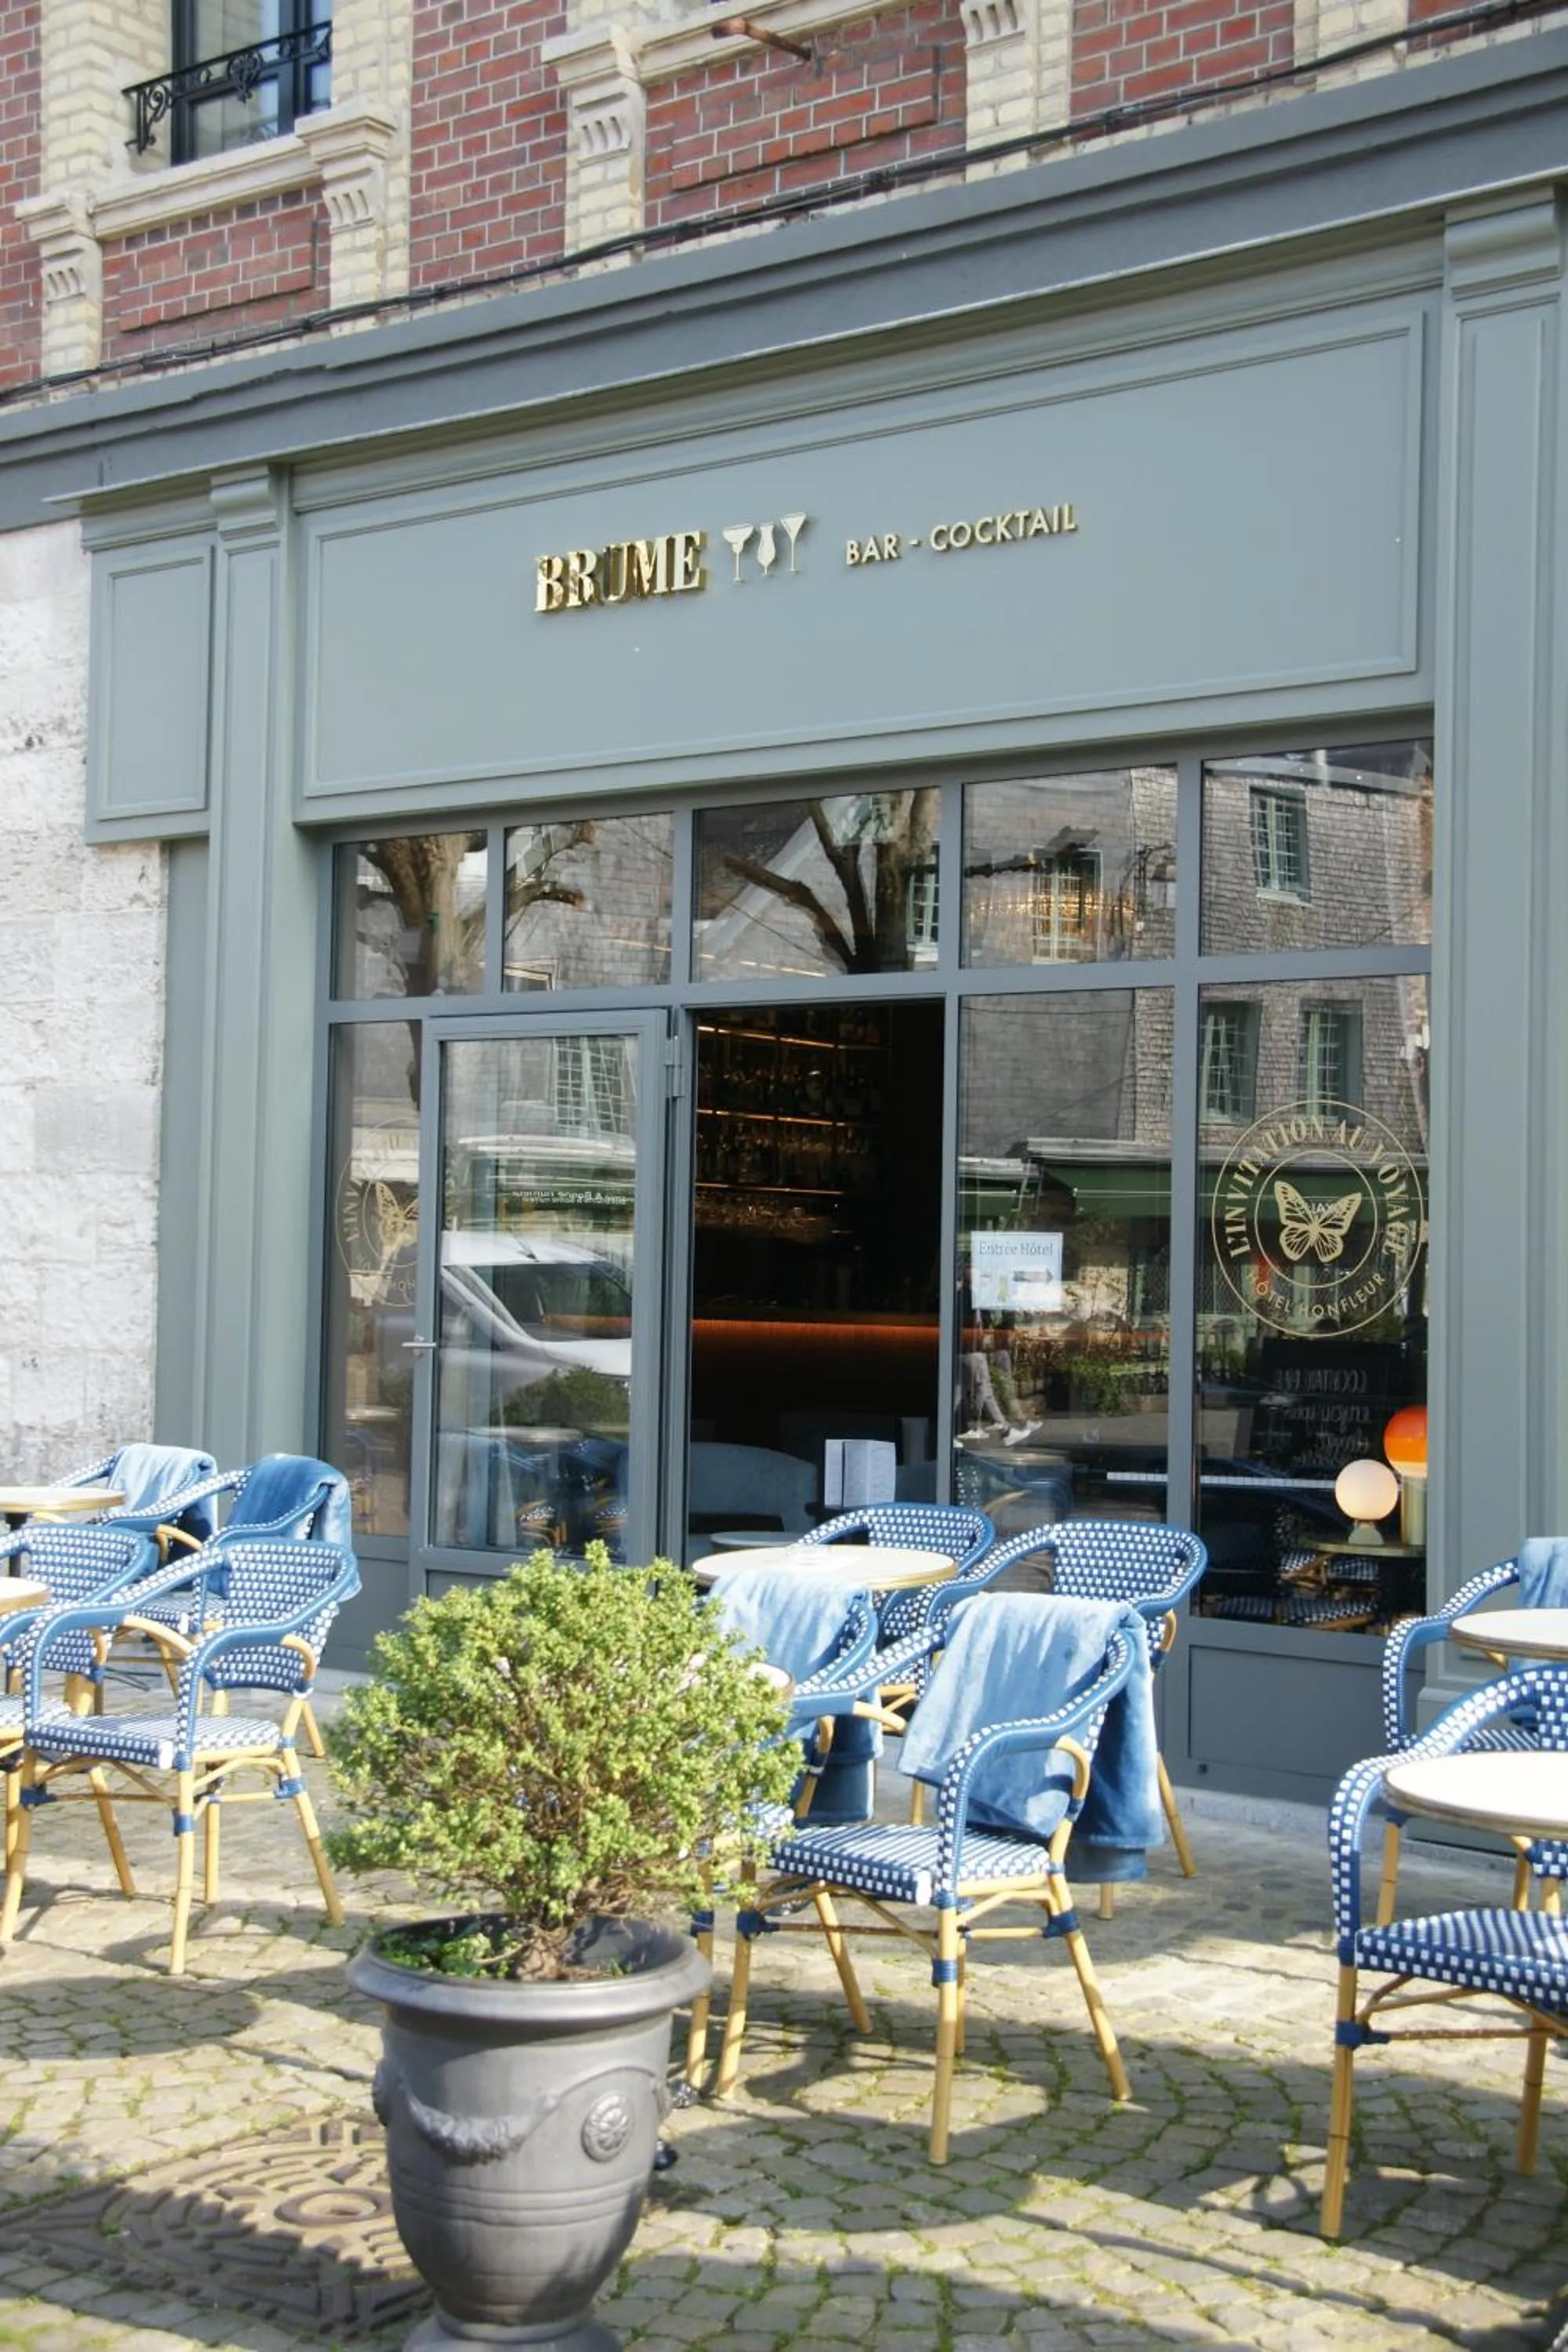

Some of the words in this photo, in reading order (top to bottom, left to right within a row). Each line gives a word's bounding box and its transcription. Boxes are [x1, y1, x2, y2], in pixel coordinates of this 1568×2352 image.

[533, 530, 707, 613] BRUME
[845, 532, 900, 567] BAR
[930, 503, 1079, 554] COCKTAIL
[1334, 1119, 1369, 1150] AU
[1369, 1142, 1410, 1257] VOYAGE
[1298, 1272, 1386, 1318] HONFLEUR
